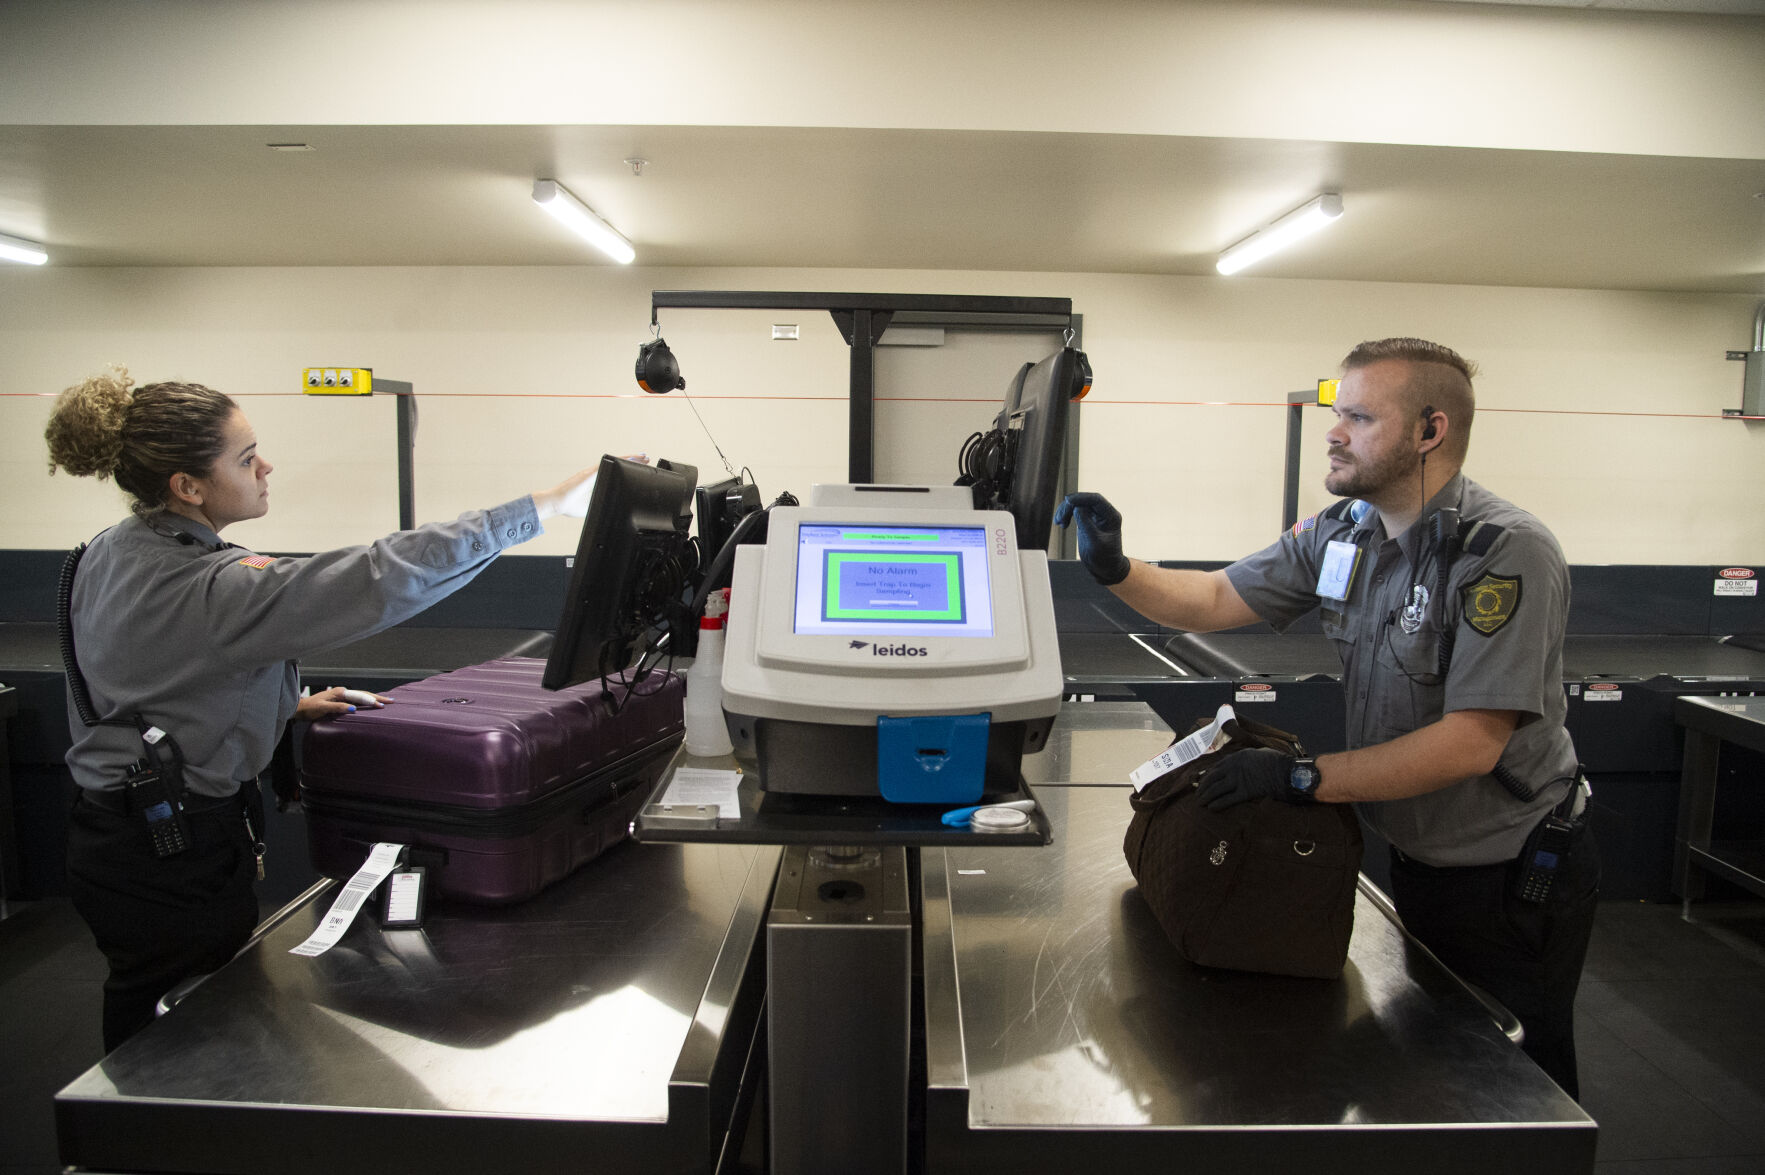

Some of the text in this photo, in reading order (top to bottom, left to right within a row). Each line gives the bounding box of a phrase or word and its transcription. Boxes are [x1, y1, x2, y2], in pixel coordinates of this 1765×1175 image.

[868, 566, 918, 576] No Alarm
[873, 643, 928, 657] leidos
